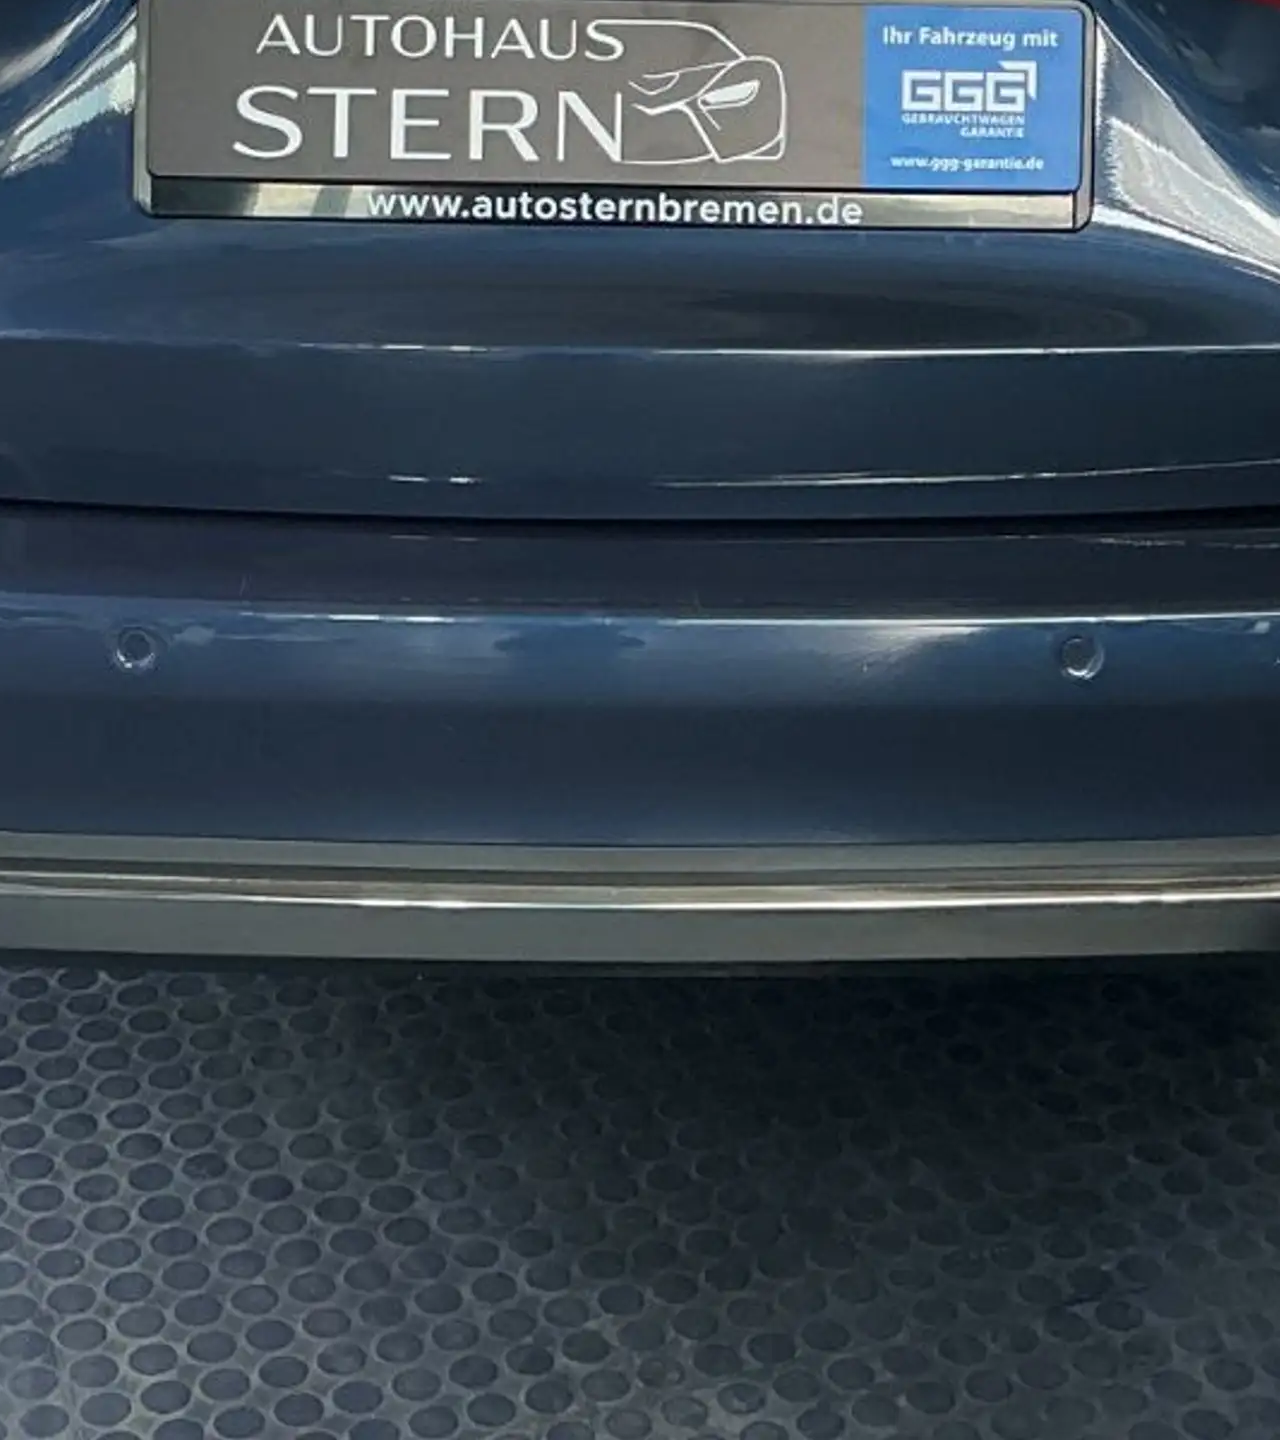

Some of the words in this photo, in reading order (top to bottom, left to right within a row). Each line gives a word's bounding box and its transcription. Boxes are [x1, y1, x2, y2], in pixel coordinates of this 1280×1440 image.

[256, 14, 625, 60] AUTOHAUS
[883, 25, 913, 45] Ihr
[920, 26, 1016, 51] Fahrzeug
[1023, 29, 1059, 47] mit
[901, 70, 1026, 112] GGG
[233, 86, 622, 162] STERN
[901, 113, 1025, 125] GEBRAUCHTWAGEN
[960, 127, 1024, 138] GARANTIE
[889, 156, 1045, 172] www.ggg-garantie.de
[366, 189, 864, 226] www.autosternbremen.de
